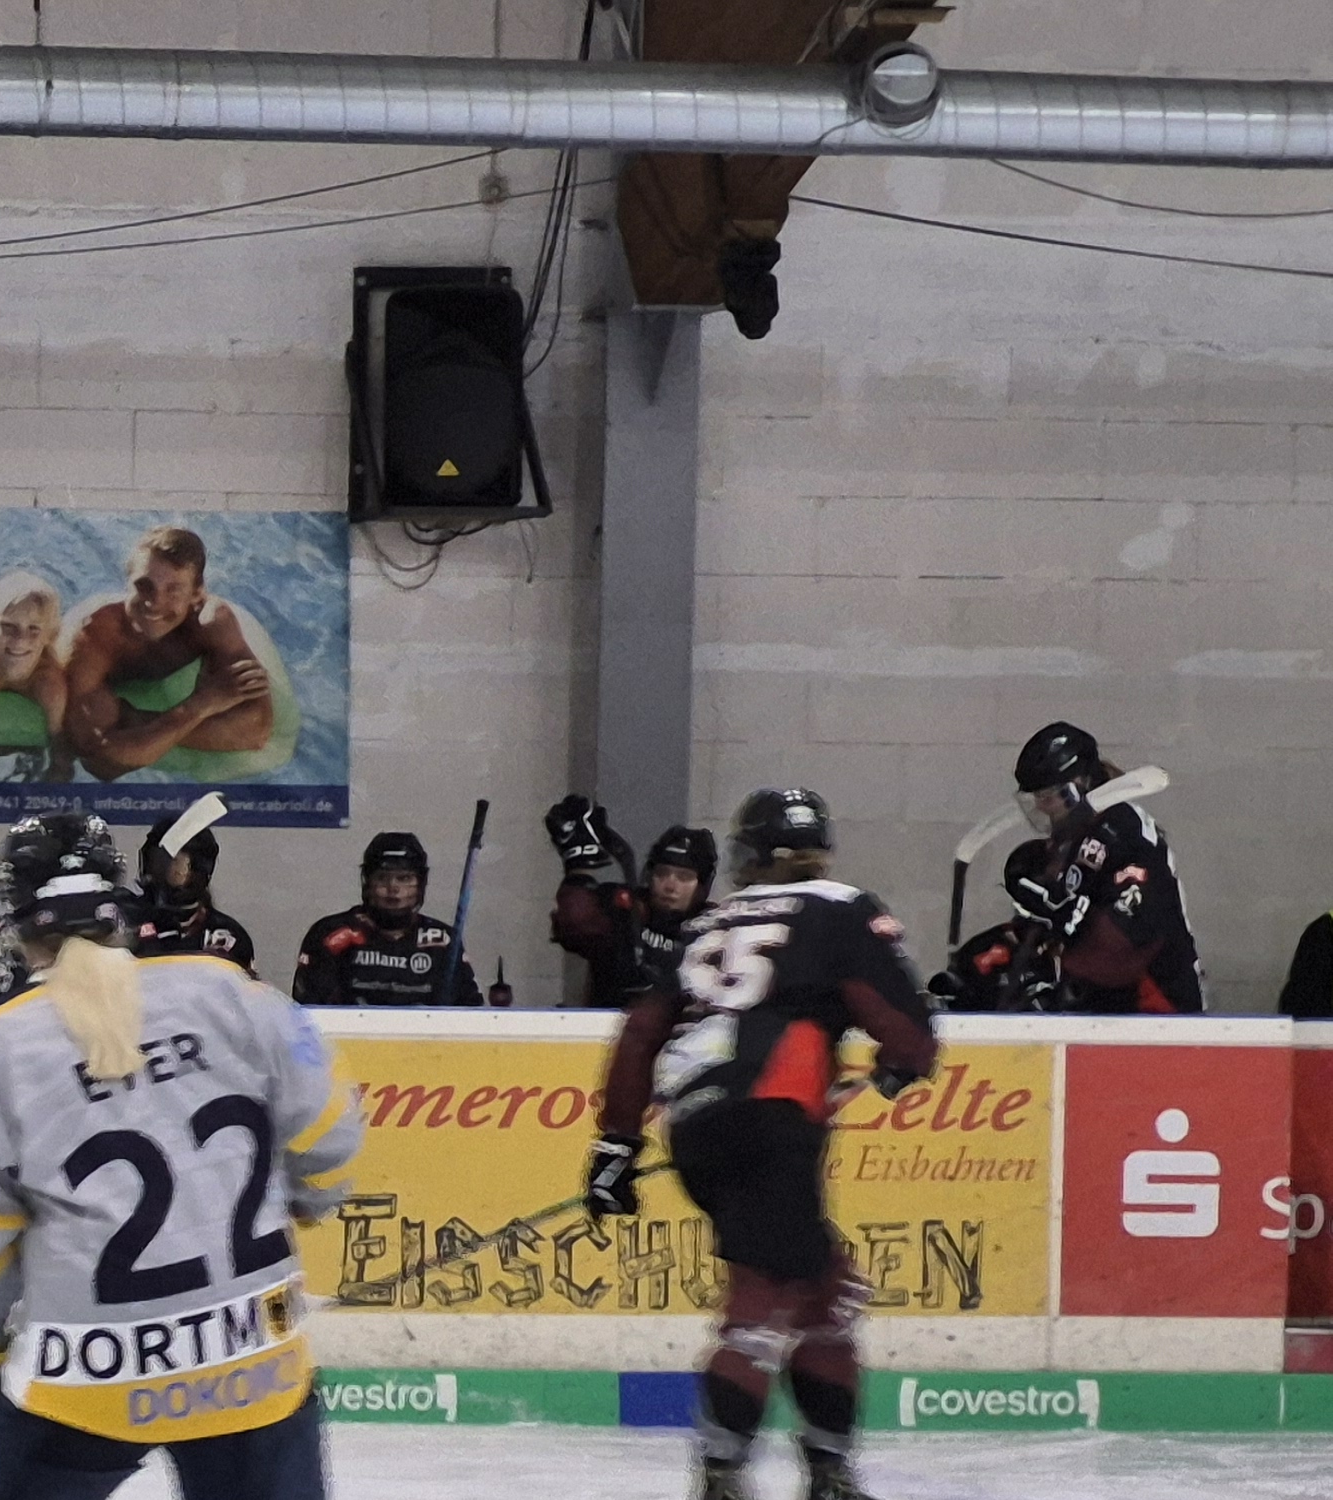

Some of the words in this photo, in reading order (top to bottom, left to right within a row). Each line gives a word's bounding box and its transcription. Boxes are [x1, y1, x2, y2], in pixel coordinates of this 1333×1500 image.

[354, 949, 409, 970] Allianz
[71, 1032, 213, 1104] EER
[355, 1080, 606, 1131] mero
[854, 1143, 1037, 1183] Eisbahnen
[59, 1092, 293, 1305] 22
[1259, 1175, 1326, 1256] Sp
[321, 1379, 434, 1412] vestro
[916, 1384, 1076, 1417] covestro
